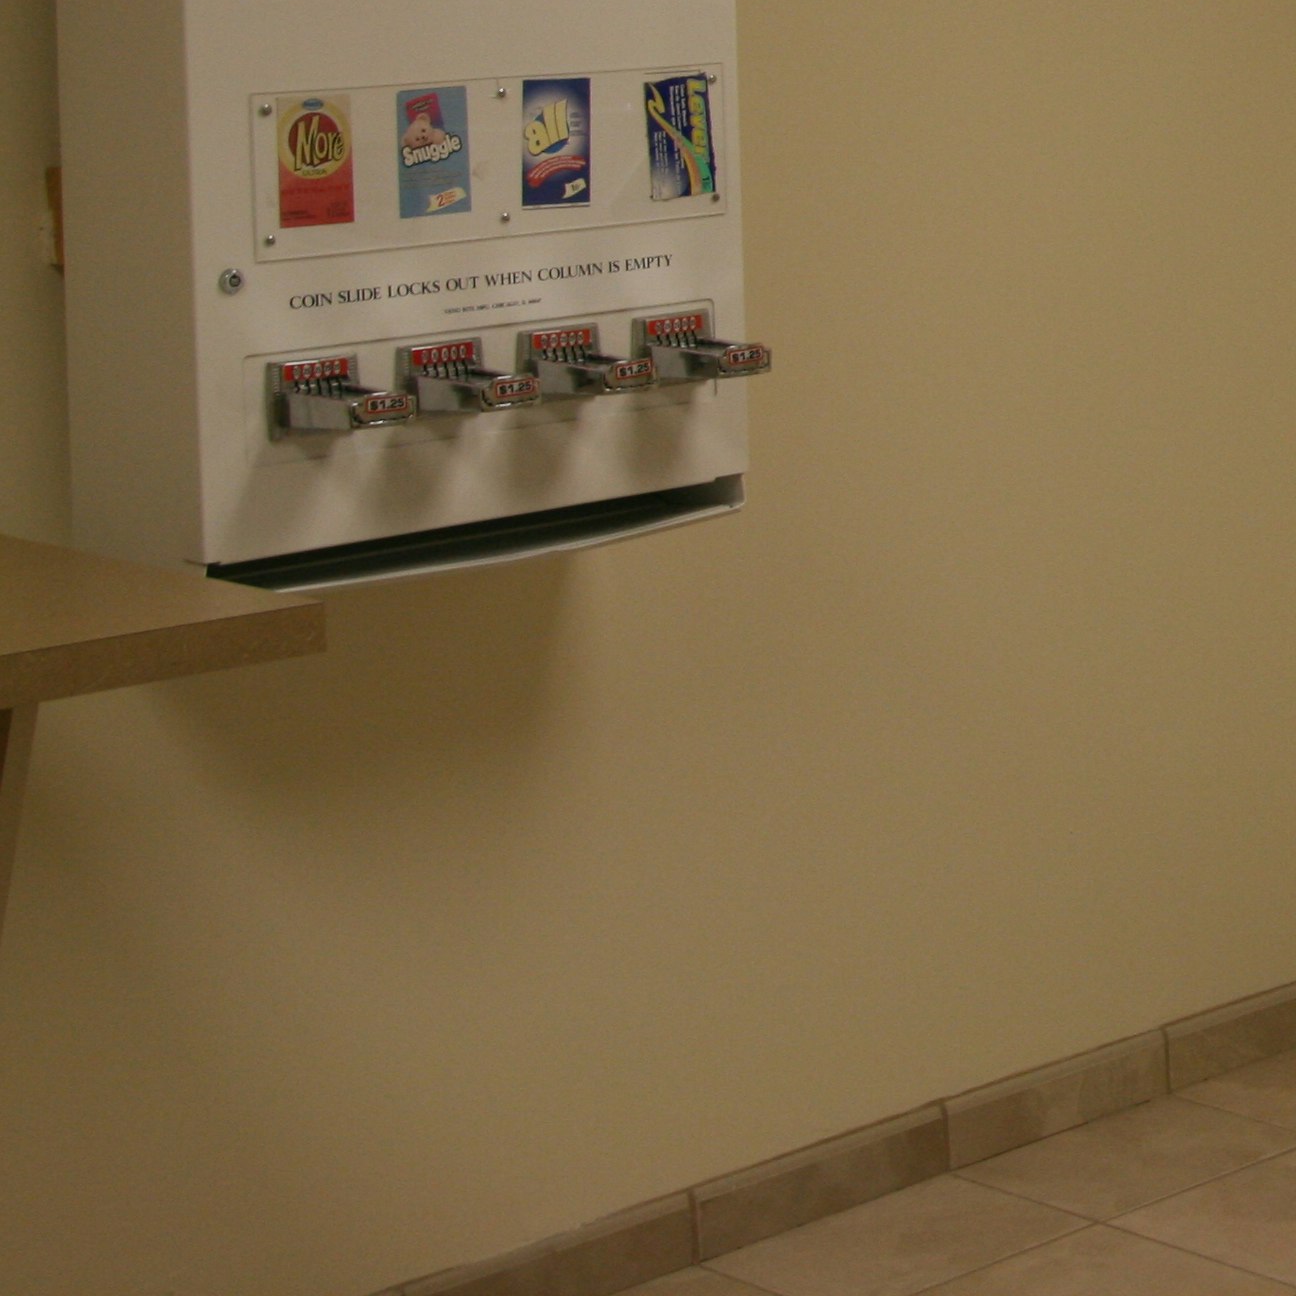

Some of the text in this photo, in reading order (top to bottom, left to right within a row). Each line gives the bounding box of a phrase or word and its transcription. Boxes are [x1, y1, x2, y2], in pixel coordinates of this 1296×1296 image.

[525, 100, 569, 156] all
[294, 114, 344, 171] More
[402, 133, 461, 167] Snuggle
[289, 254, 673, 310] COIN SLIDE LOCKS OUT WHEN COLUMN IS EMPTY
[732, 350, 761, 362] $1.25
[619, 362, 649, 376] $1.25
[499, 381, 531, 394] $1.25
[370, 398, 404, 410] $1.25
